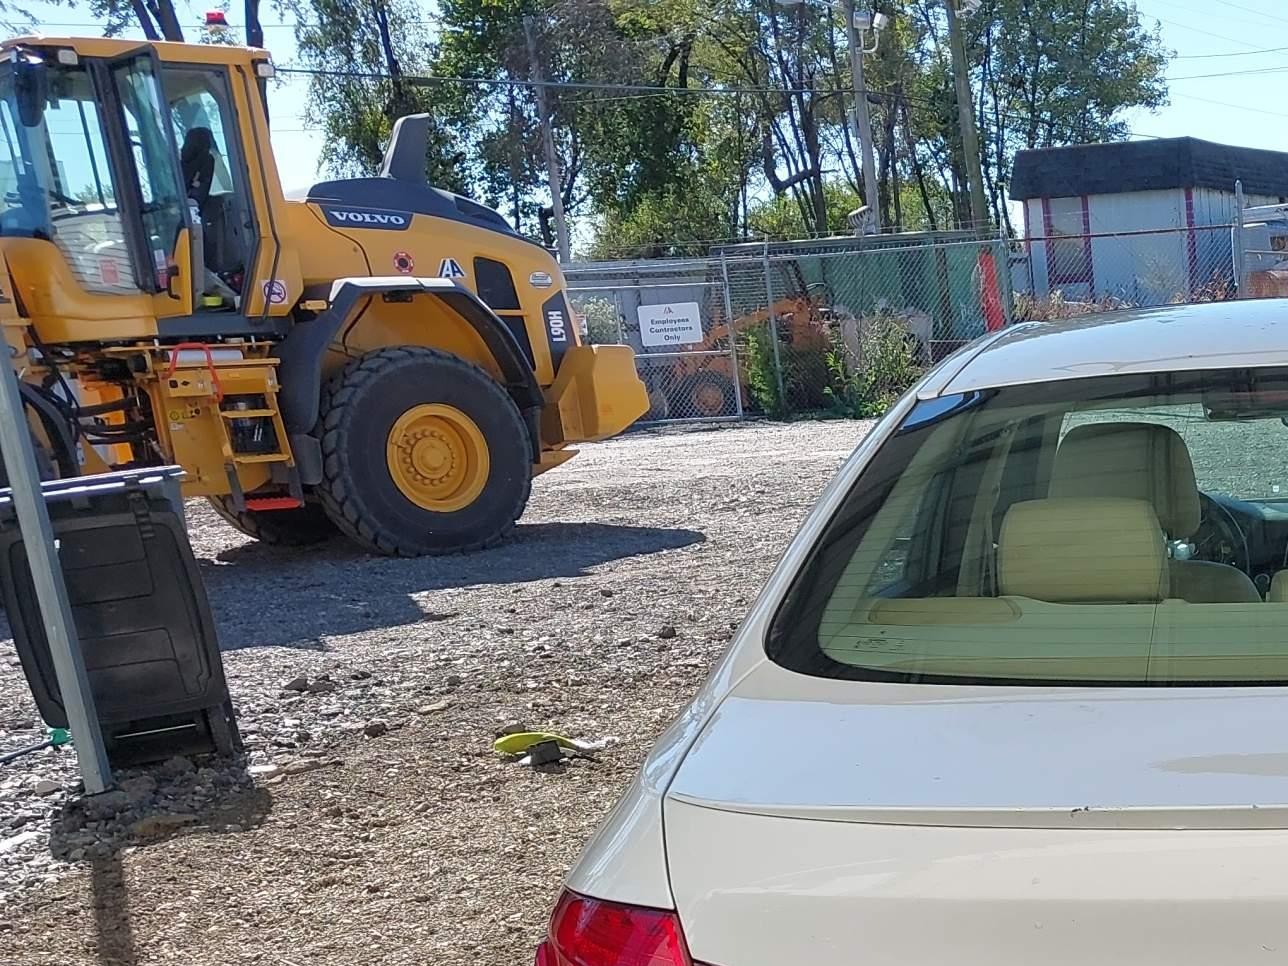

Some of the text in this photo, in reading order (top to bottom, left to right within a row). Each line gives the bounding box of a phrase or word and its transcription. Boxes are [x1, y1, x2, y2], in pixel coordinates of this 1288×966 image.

[330, 210, 405, 225] VOLVO
[547, 310, 567, 342] L90H
[650, 317, 690, 326] Employees
[649, 325, 693, 334] Contractors
